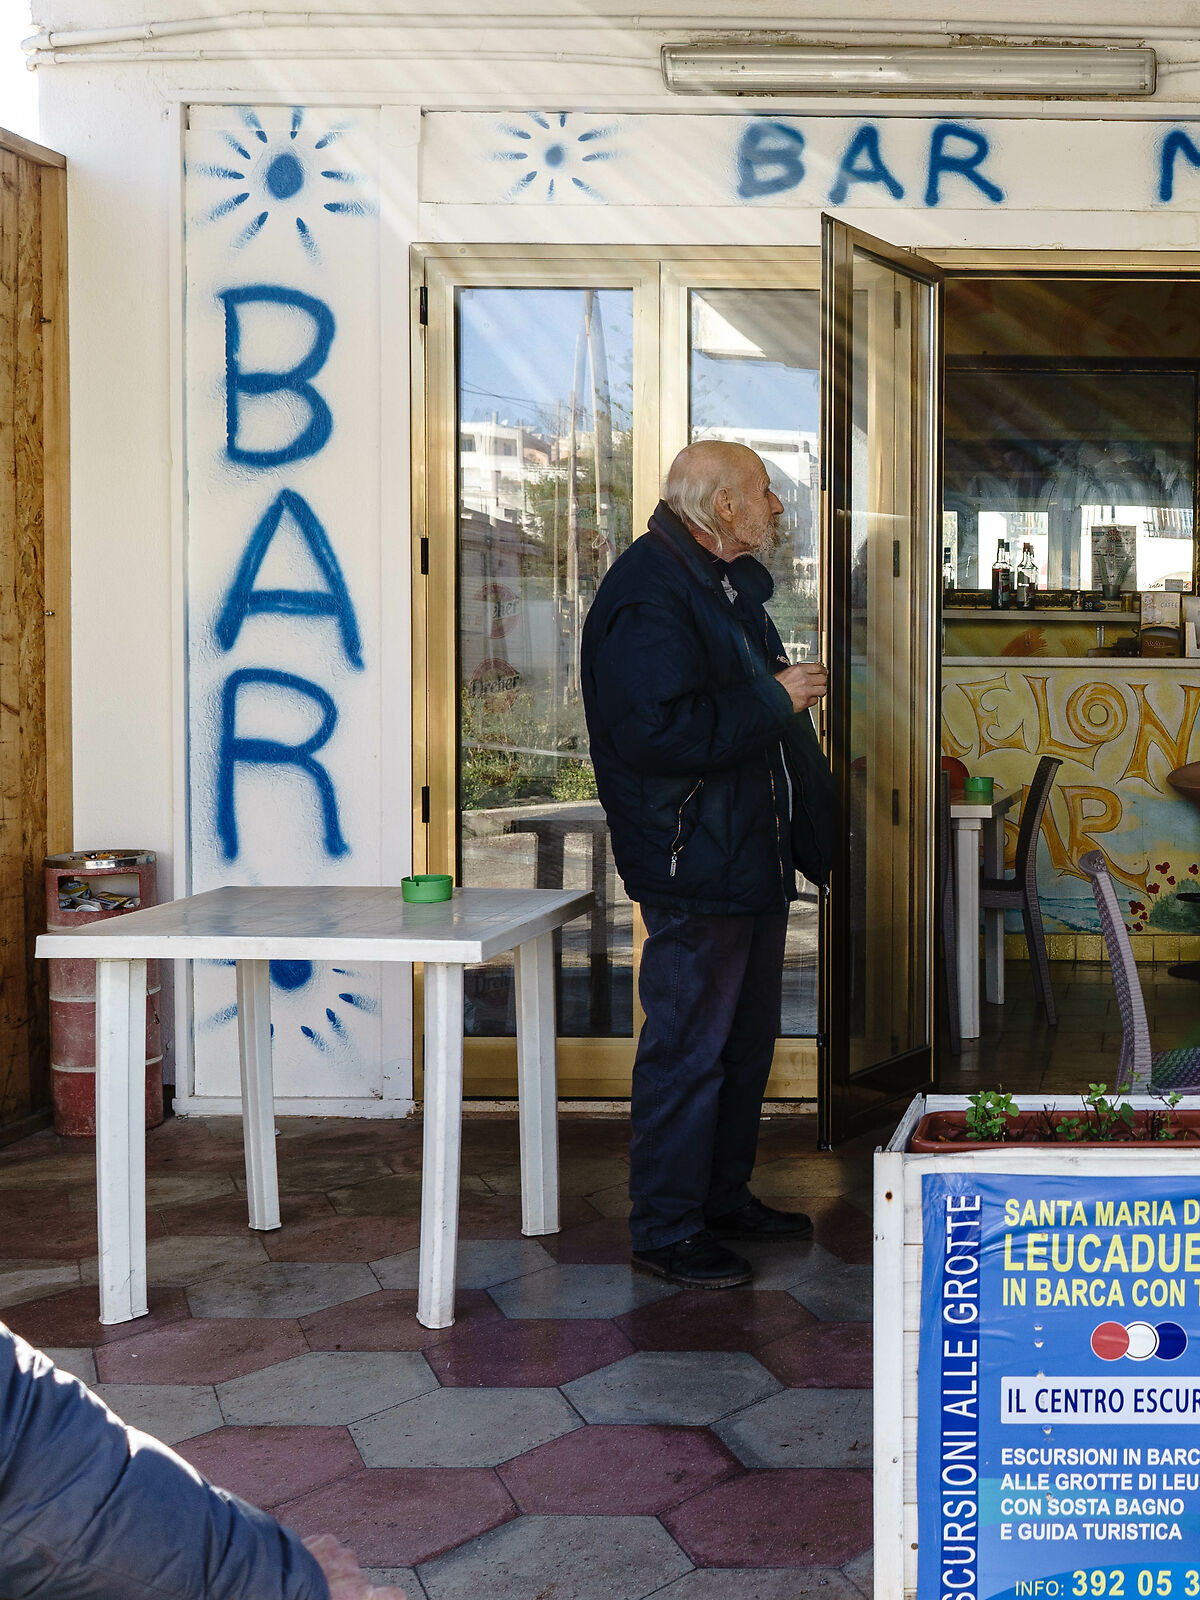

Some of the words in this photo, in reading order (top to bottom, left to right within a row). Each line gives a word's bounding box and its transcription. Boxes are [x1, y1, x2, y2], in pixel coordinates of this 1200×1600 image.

[738, 120, 1006, 207] BAR
[216, 284, 366, 862] BAR
[1004, 1198, 1088, 1227] SANTA
[1095, 1200, 1177, 1227] MARIA
[943, 1195, 981, 1324] GROTTE
[1002, 1278, 1027, 1306] IN
[1035, 1278, 1126, 1307] BARCA
[1132, 1279, 1186, 1307] CON
[943, 1339, 978, 1419] ALLE
[1007, 1388, 1027, 1413] IL
[1035, 1388, 1125, 1414] CENTRO
[1001, 1448, 1119, 1466] ESCURSIONI
[1123, 1448, 1142, 1465] IN
[1000, 1473, 1050, 1490] ALLE
[1055, 1473, 1133, 1491] GROTTE
[1138, 1473, 1157, 1491] DI
[1000, 1498, 1042, 1516] CON
[1047, 1498, 1111, 1516] SOSTA
[1115, 1498, 1185, 1516] BAGNO
[1001, 1523, 1012, 1540] E
[1017, 1523, 1079, 1540] GUIDA
[1082, 1523, 1183, 1541] TURISTICA
[1015, 1580, 1065, 1597] INFO:
[1071, 1569, 1125, 1597] 392
[1137, 1569, 1173, 1597] 05
